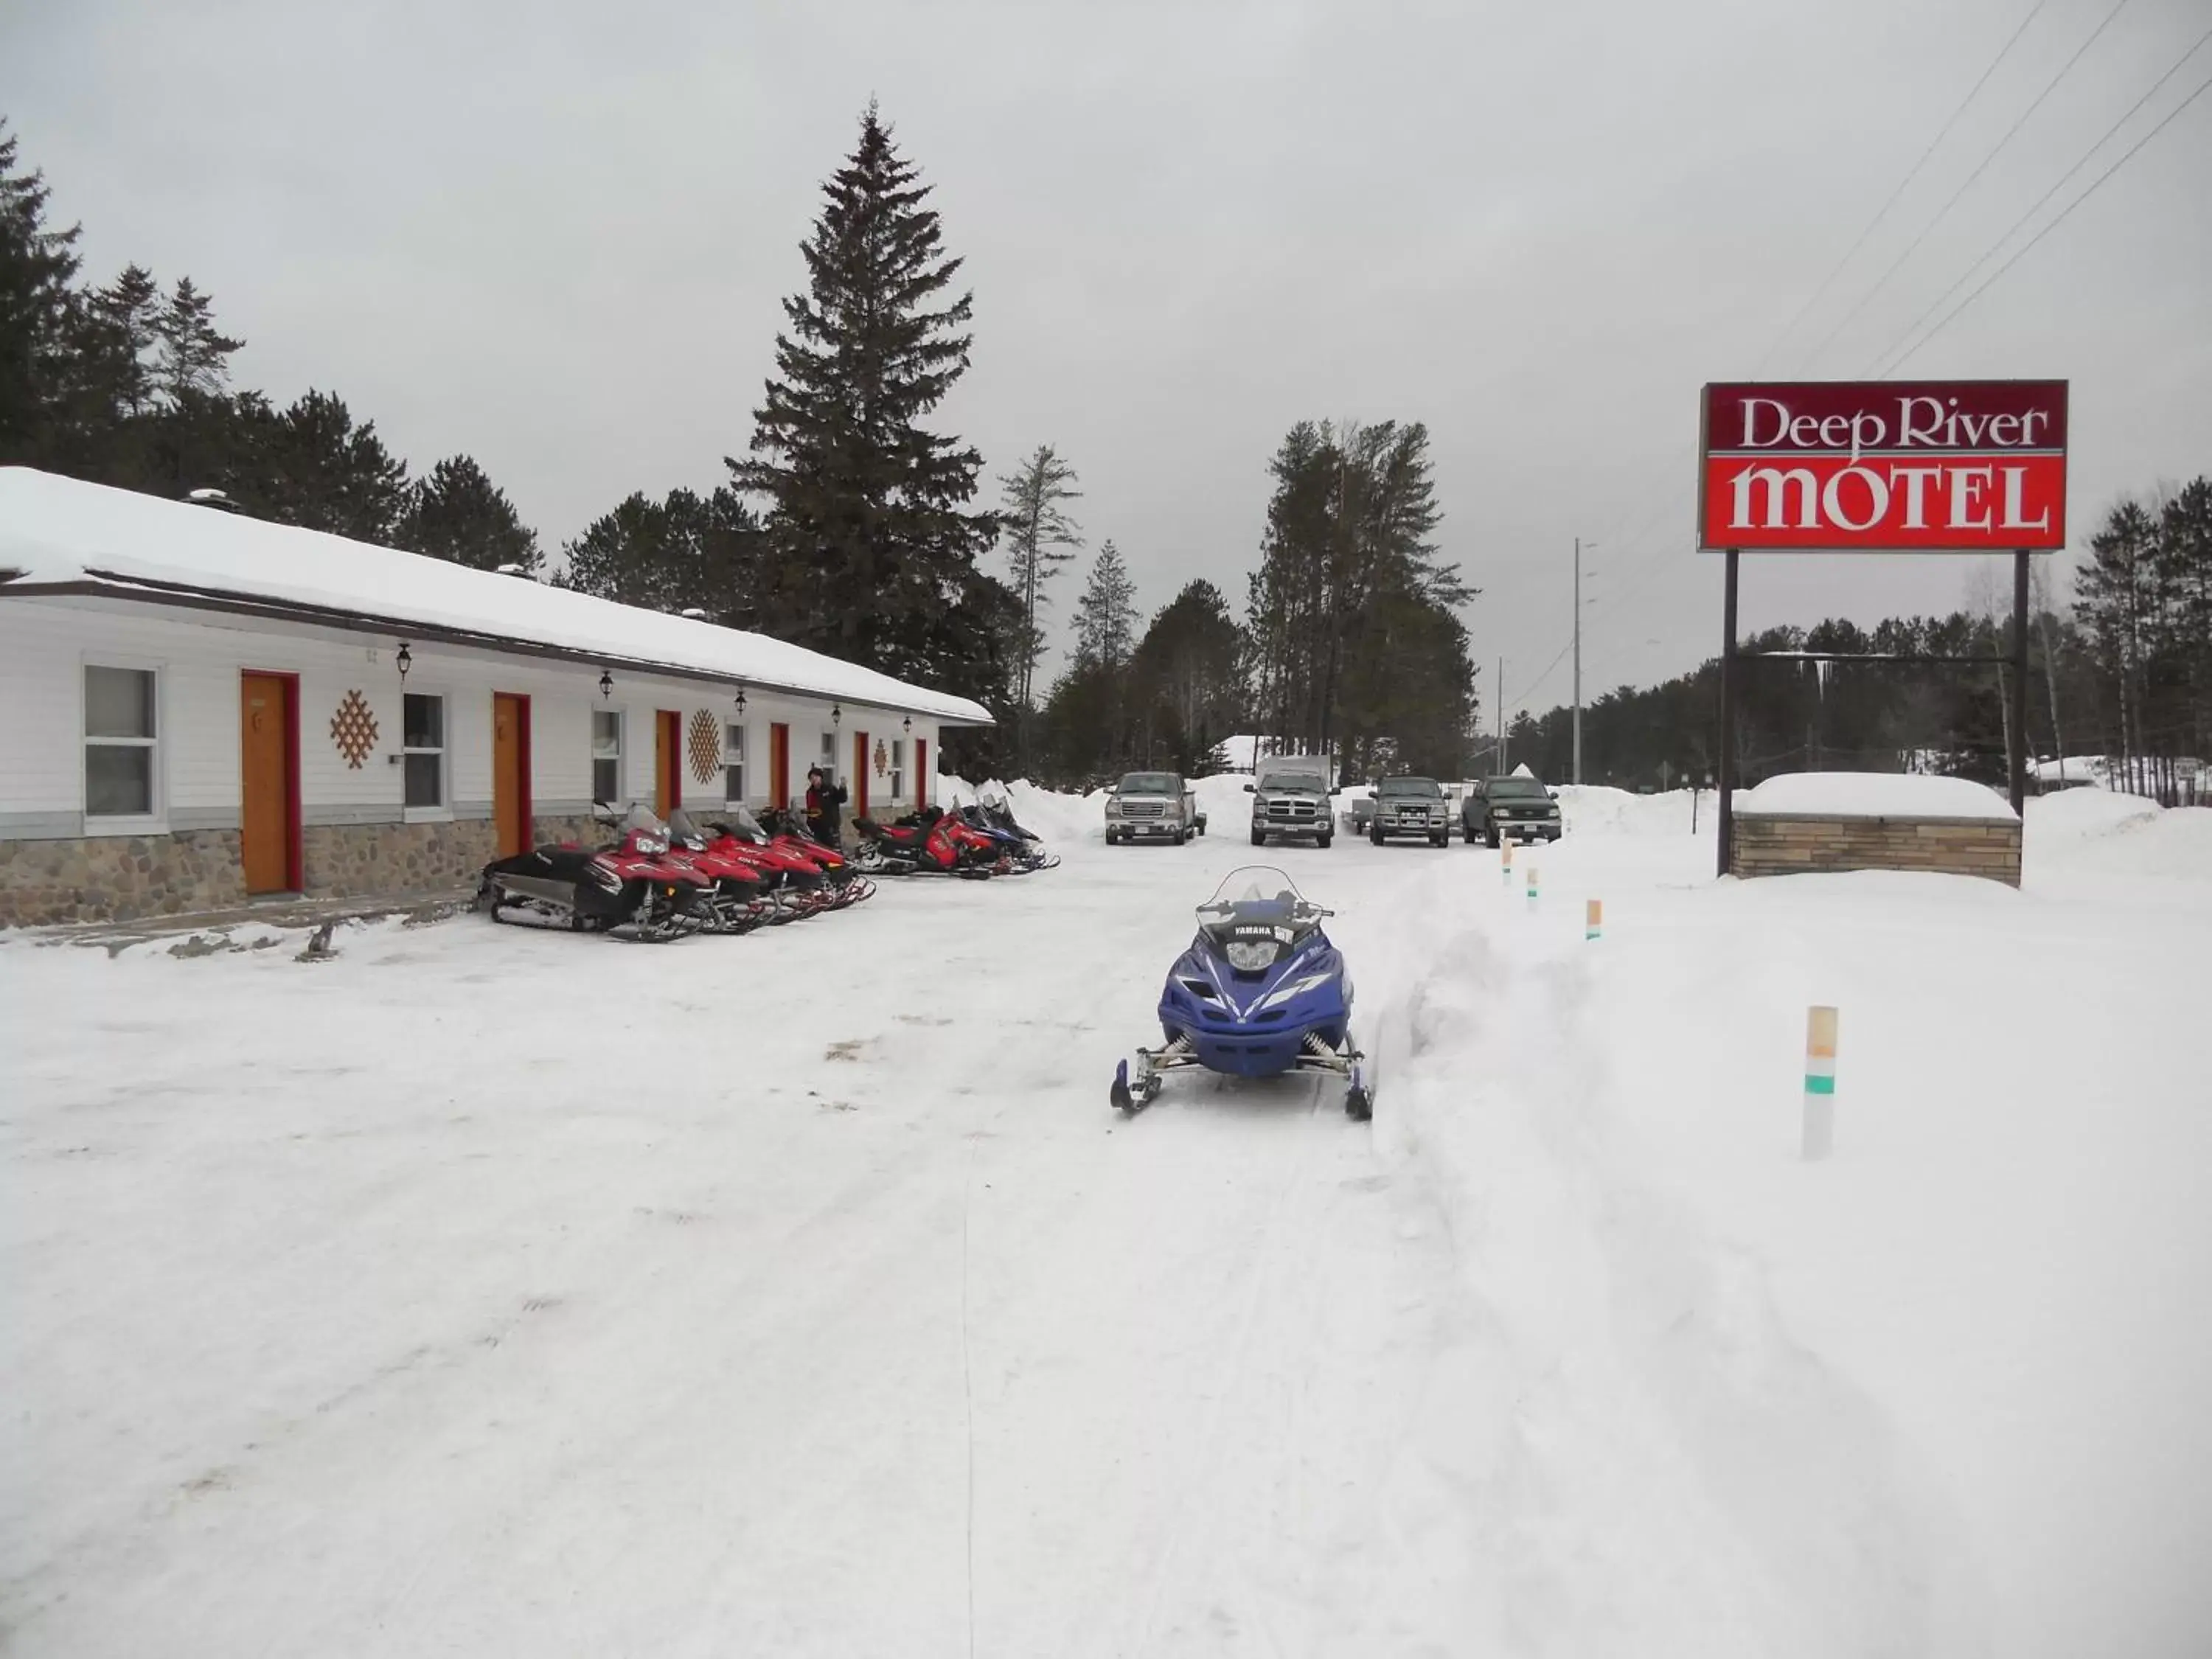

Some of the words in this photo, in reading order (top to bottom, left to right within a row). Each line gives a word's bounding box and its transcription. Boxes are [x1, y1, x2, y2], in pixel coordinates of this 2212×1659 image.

[1738, 398, 1885, 465] Deep
[1895, 397, 2048, 447] River
[1235, 926, 1271, 935] YAMAHA
